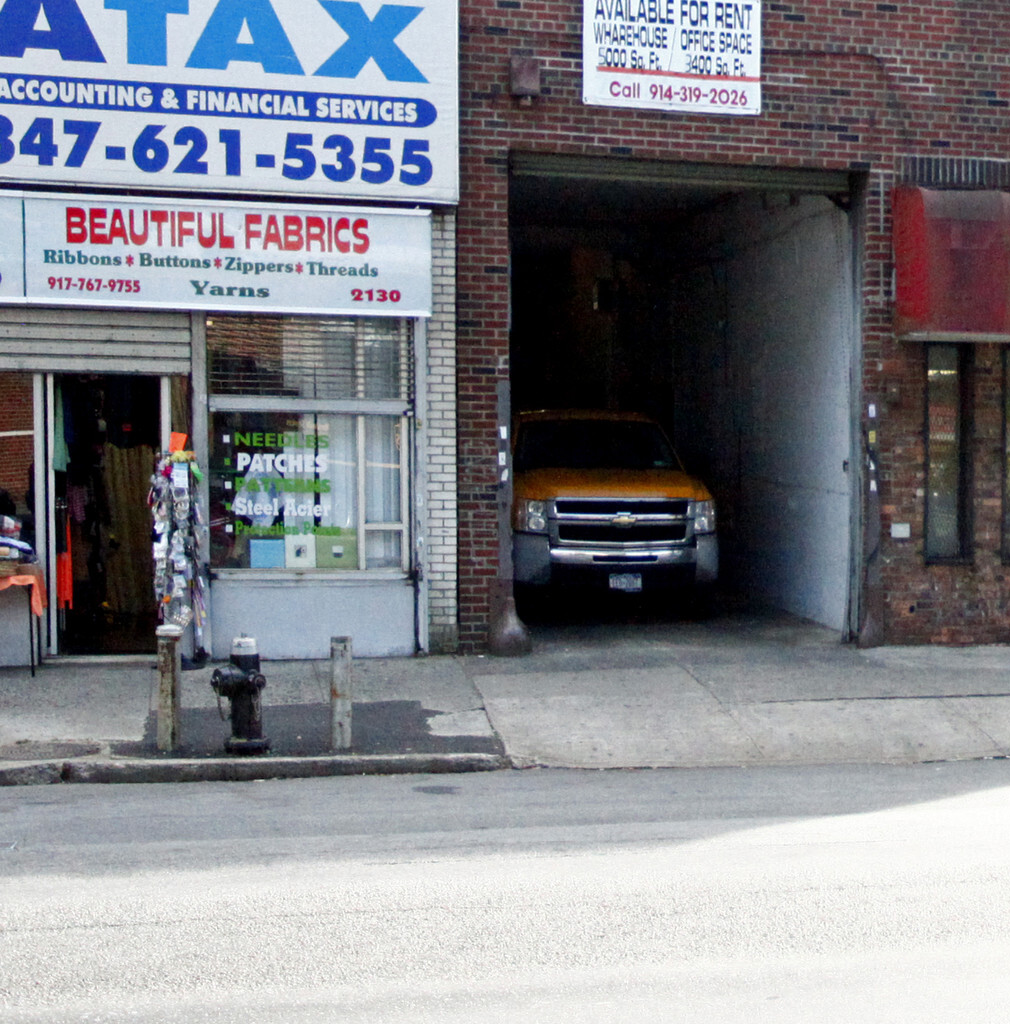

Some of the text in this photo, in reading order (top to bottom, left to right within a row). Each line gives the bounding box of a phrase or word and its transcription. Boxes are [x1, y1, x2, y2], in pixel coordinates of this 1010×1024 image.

[680, 0, 709, 28] FOR
[715, 2, 752, 30] RENT
[593, 22, 668, 49] WHAREHOUSE
[681, 29, 752, 55] OFFICE SPACE
[598, 47, 627, 67] 5000
[685, 54, 712, 75] 3400
[0, 78, 418, 123] ACCOUNTING & FINANCIAL SERVICES
[609, 81, 748, 106] Call 914-319-2026
[66, 207, 370, 254] BEAUTIFUL FABRICS
[43, 249, 379, 278] Ribbons Buttons Zippers Threads
[48, 276, 402, 303] 917-767-9755 Yarns 2130
[237, 452, 328, 473] PATCHES
[235, 498, 333, 518] Steel Acier
